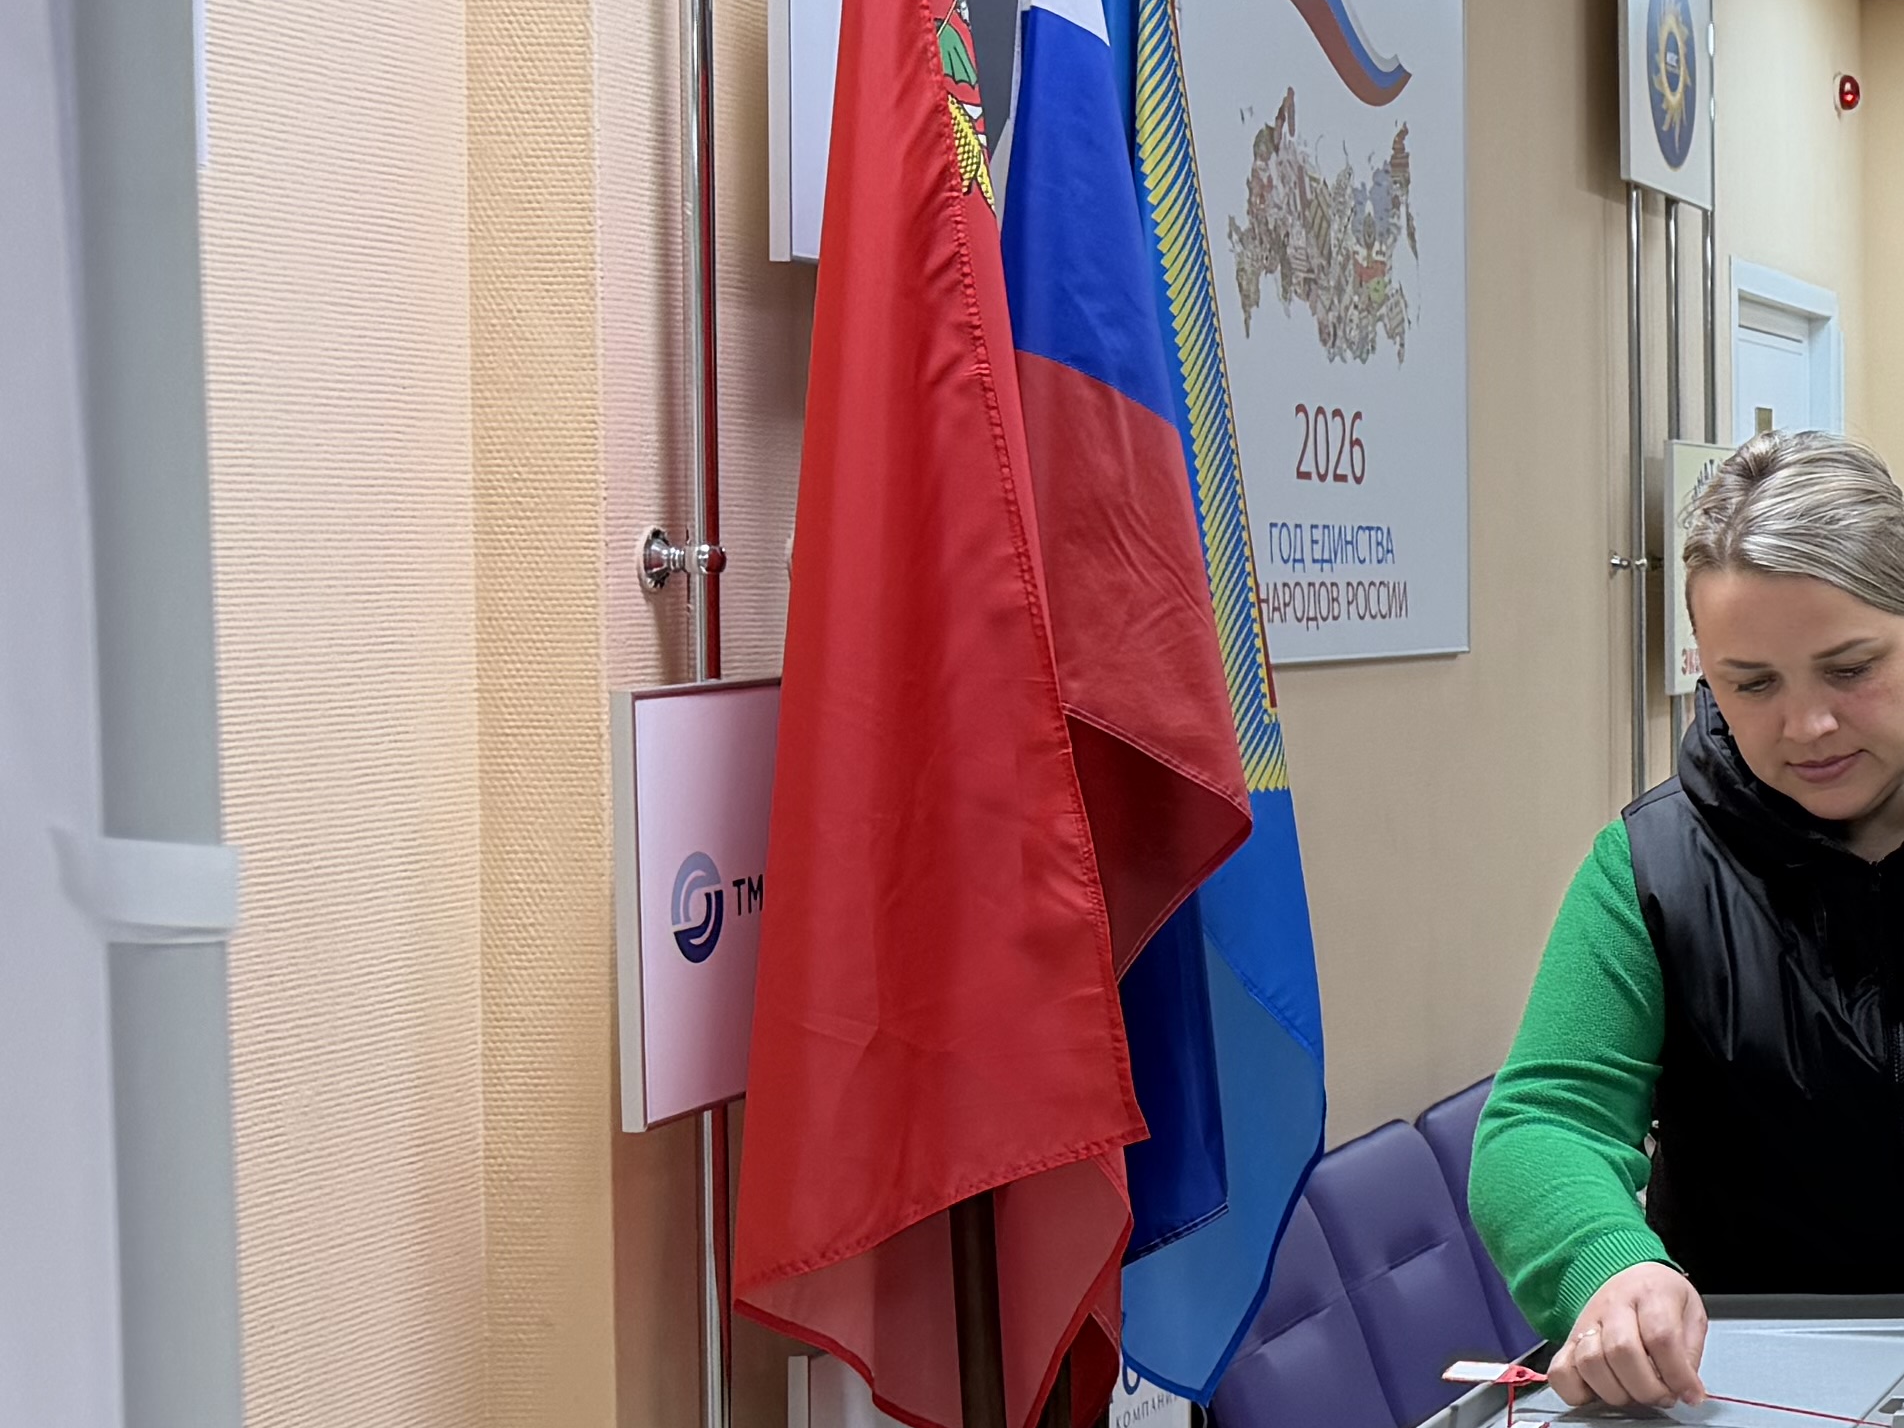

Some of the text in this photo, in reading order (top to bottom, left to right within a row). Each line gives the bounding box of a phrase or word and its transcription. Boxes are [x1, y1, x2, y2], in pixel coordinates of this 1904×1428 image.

[1295, 403, 1366, 486] 2026
[1268, 522, 1396, 573] ГОД ЕДИНСТВА
[1258, 580, 1409, 632] НАРОДОВ РОССИИ
